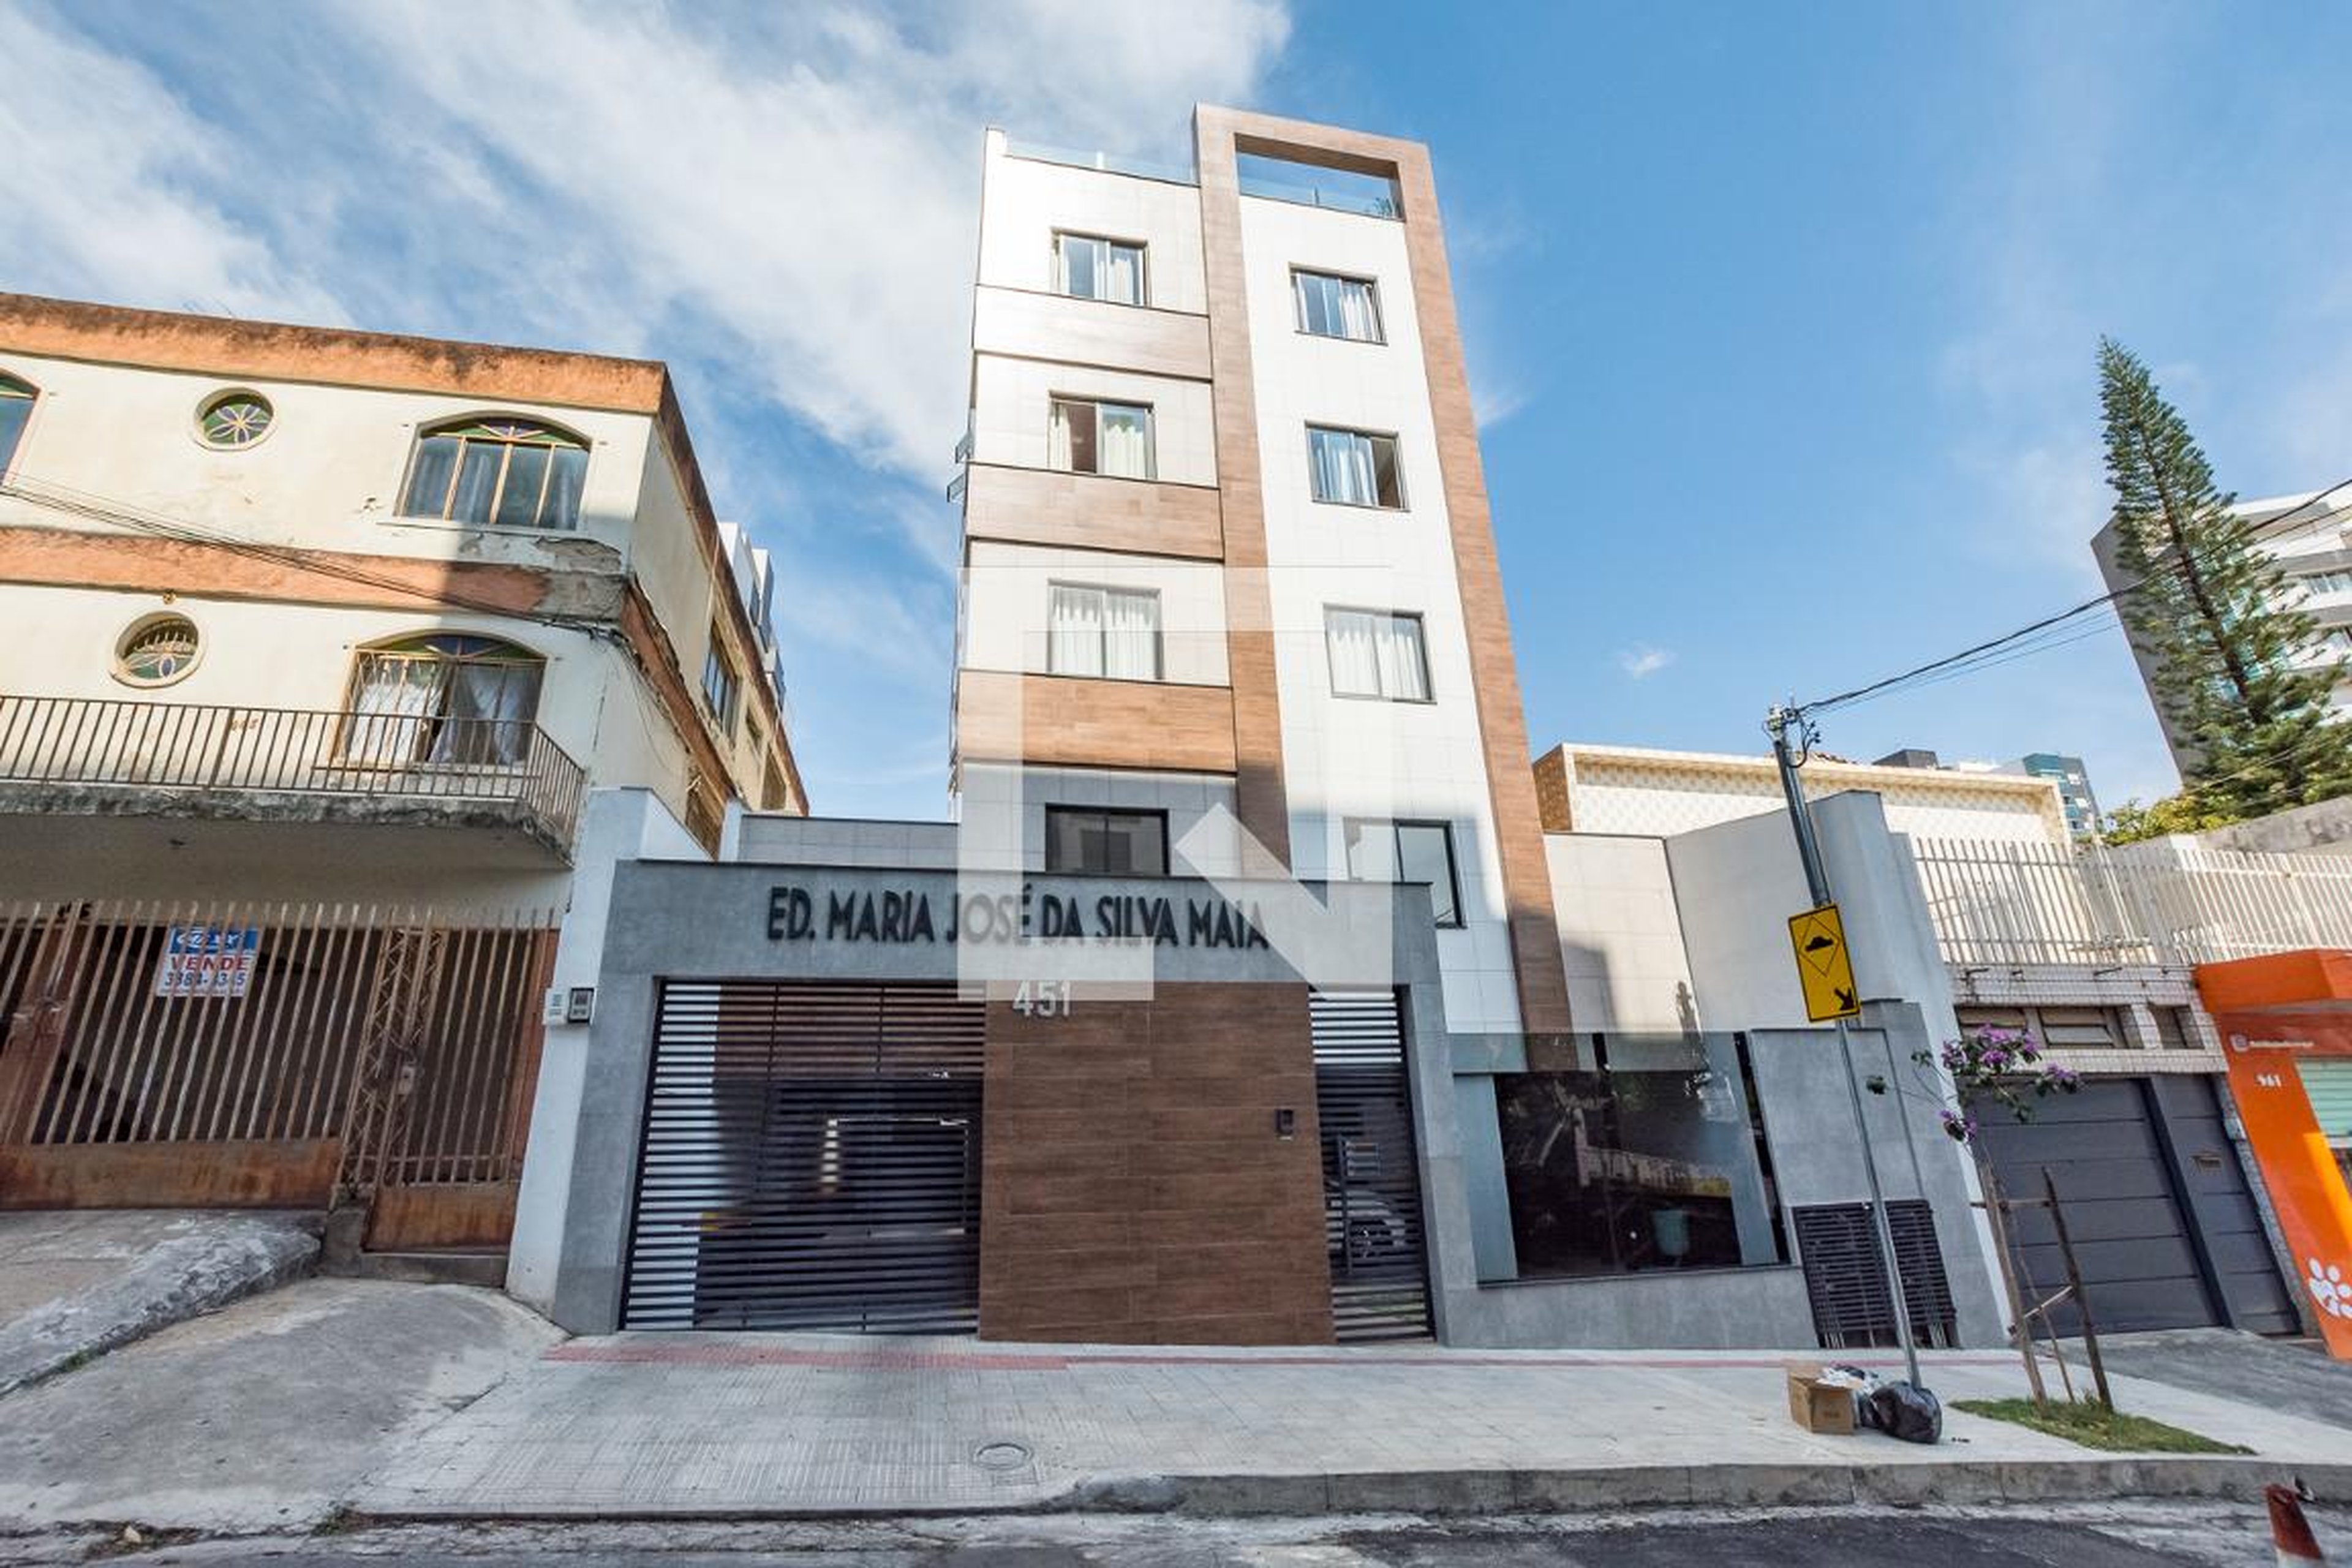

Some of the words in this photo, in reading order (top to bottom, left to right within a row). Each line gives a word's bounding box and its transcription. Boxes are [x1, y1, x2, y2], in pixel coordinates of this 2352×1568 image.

[767, 886, 816, 941] ED.
[827, 890, 935, 943] MARIA
[947, 883, 1033, 946] JOSÉ
[1042, 894, 1085, 946] DA
[1095, 895, 1179, 948] SILVA
[1189, 897, 1270, 949] MAIA
[170, 956, 251, 971] VENDE
[1012, 980, 1071, 1017] 451
